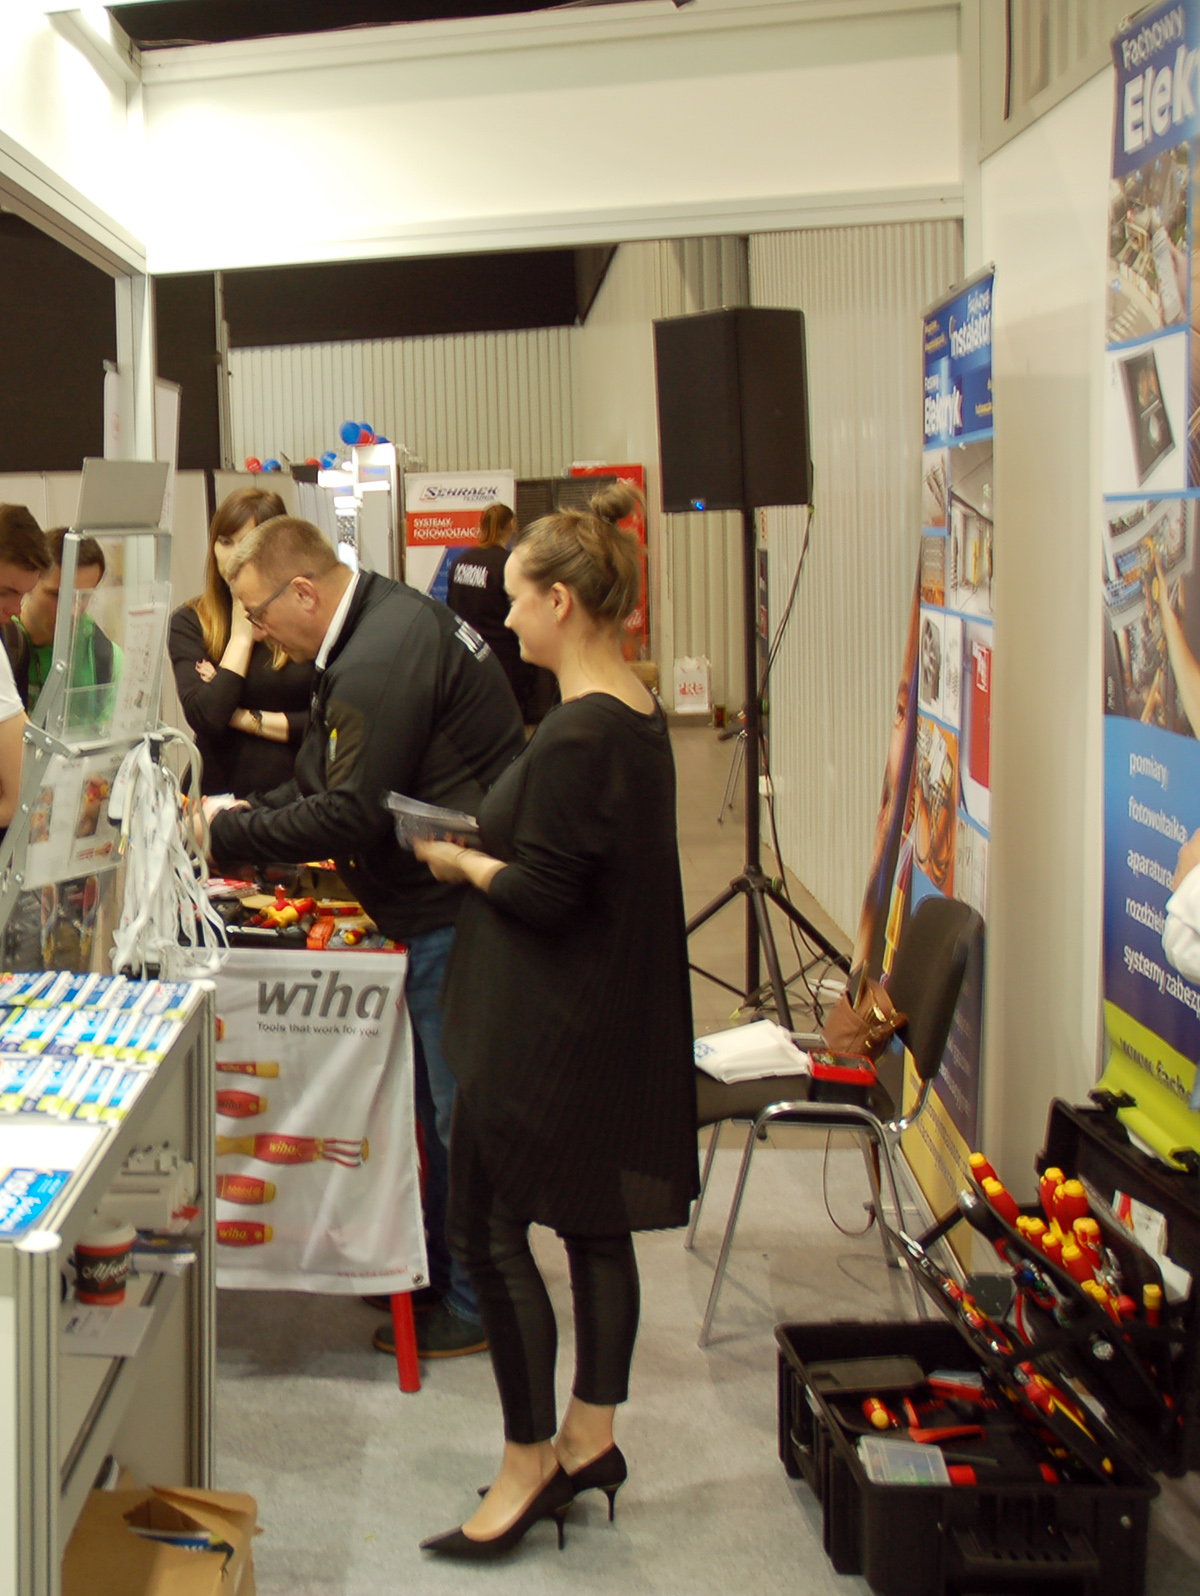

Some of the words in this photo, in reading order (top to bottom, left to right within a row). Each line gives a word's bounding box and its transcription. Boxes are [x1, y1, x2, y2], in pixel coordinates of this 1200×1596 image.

[1121, 4, 1185, 72] Fachowy
[1124, 44, 1200, 155] Elek
[424, 486, 498, 499] SCHRACK
[413, 517, 452, 528] SYSTEMY
[1129, 752, 1170, 792] pomiary
[1128, 795, 1188, 845] fotowoltaika
[1126, 849, 1174, 893] aparatura
[1123, 944, 1165, 994] systemy
[257, 969, 391, 1020] wiha
[257, 1022, 286, 1032] Tools
[289, 1023, 311, 1033] that
[313, 1025, 340, 1034] work
[342, 1024, 356, 1035] for
[269, 1140, 297, 1154] wiha
[219, 1227, 248, 1241] wiha
